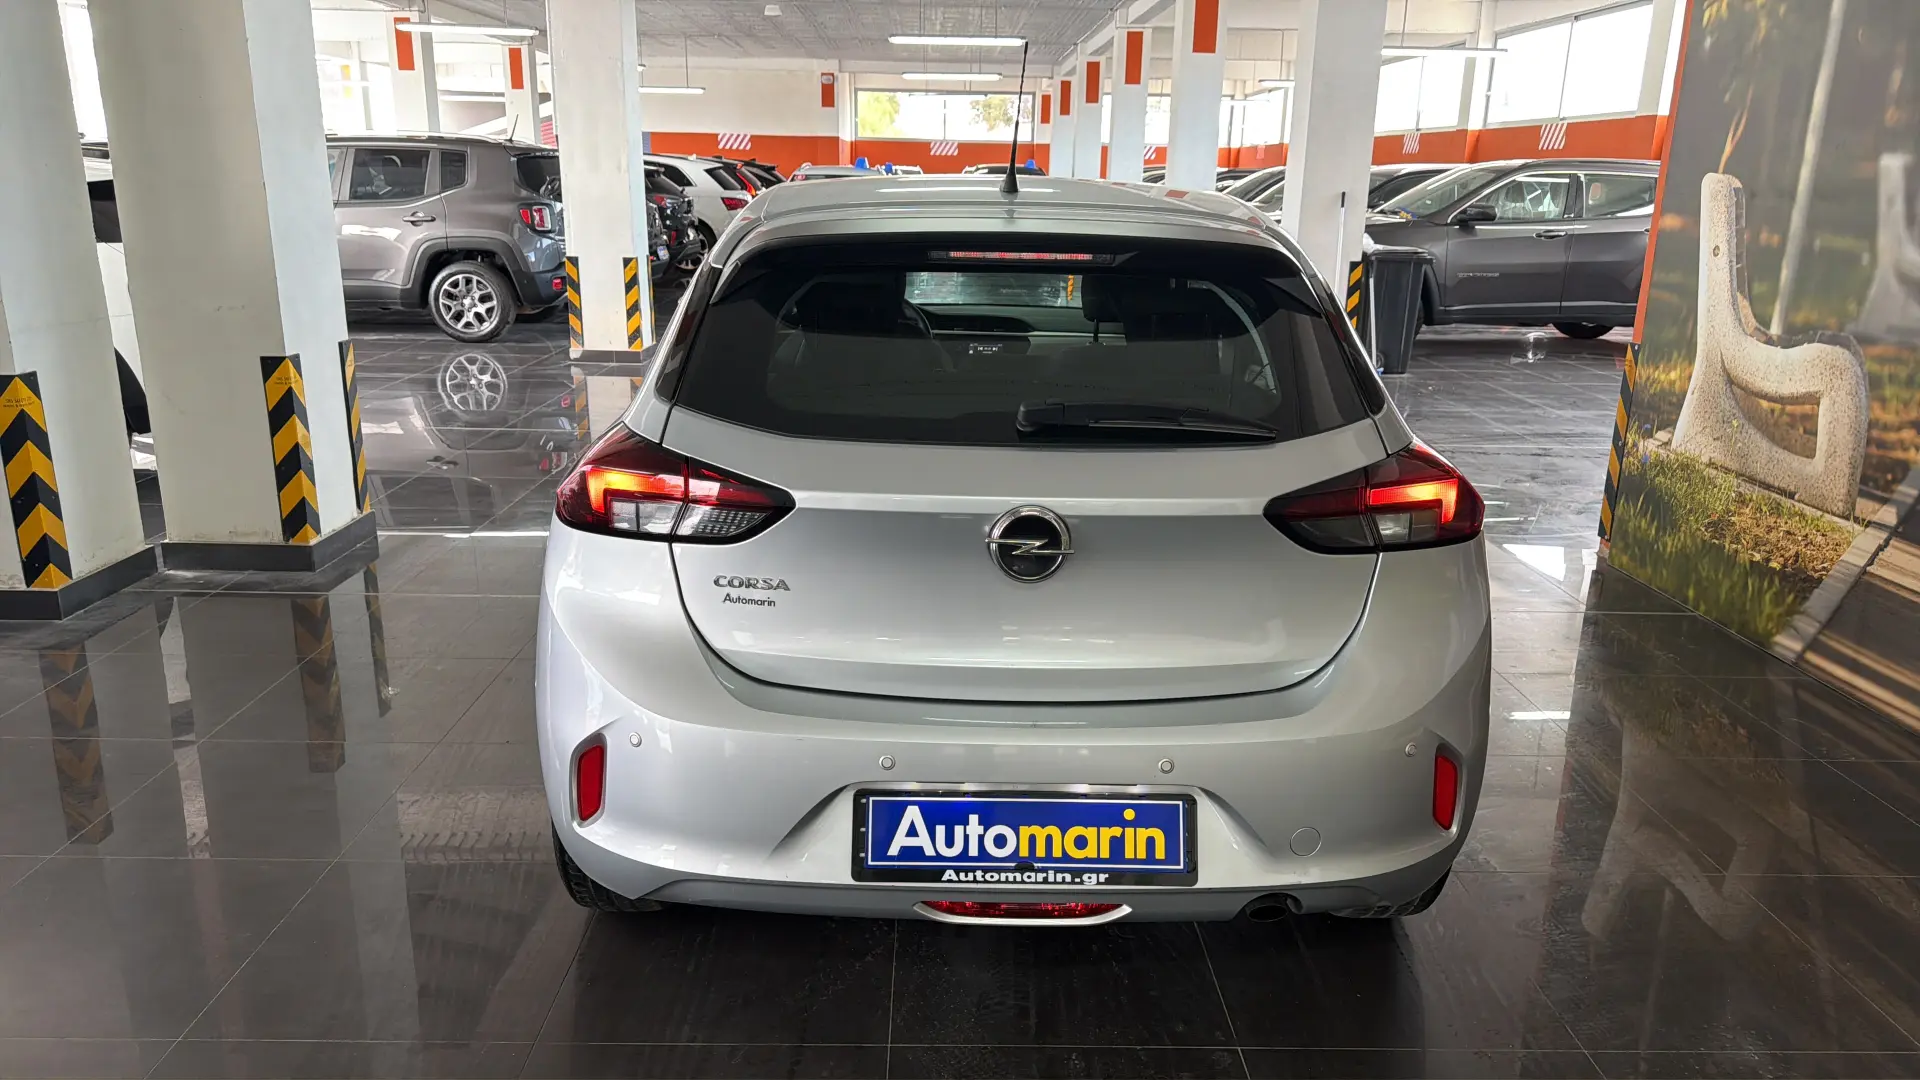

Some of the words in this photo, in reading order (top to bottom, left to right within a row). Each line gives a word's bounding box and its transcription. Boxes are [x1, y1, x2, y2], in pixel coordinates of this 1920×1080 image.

[713, 575, 791, 591] CORSA
[723, 593, 775, 607] Automarin
[887, 805, 1166, 859] Automarin
[941, 869, 1109, 885] Automarin.gr
